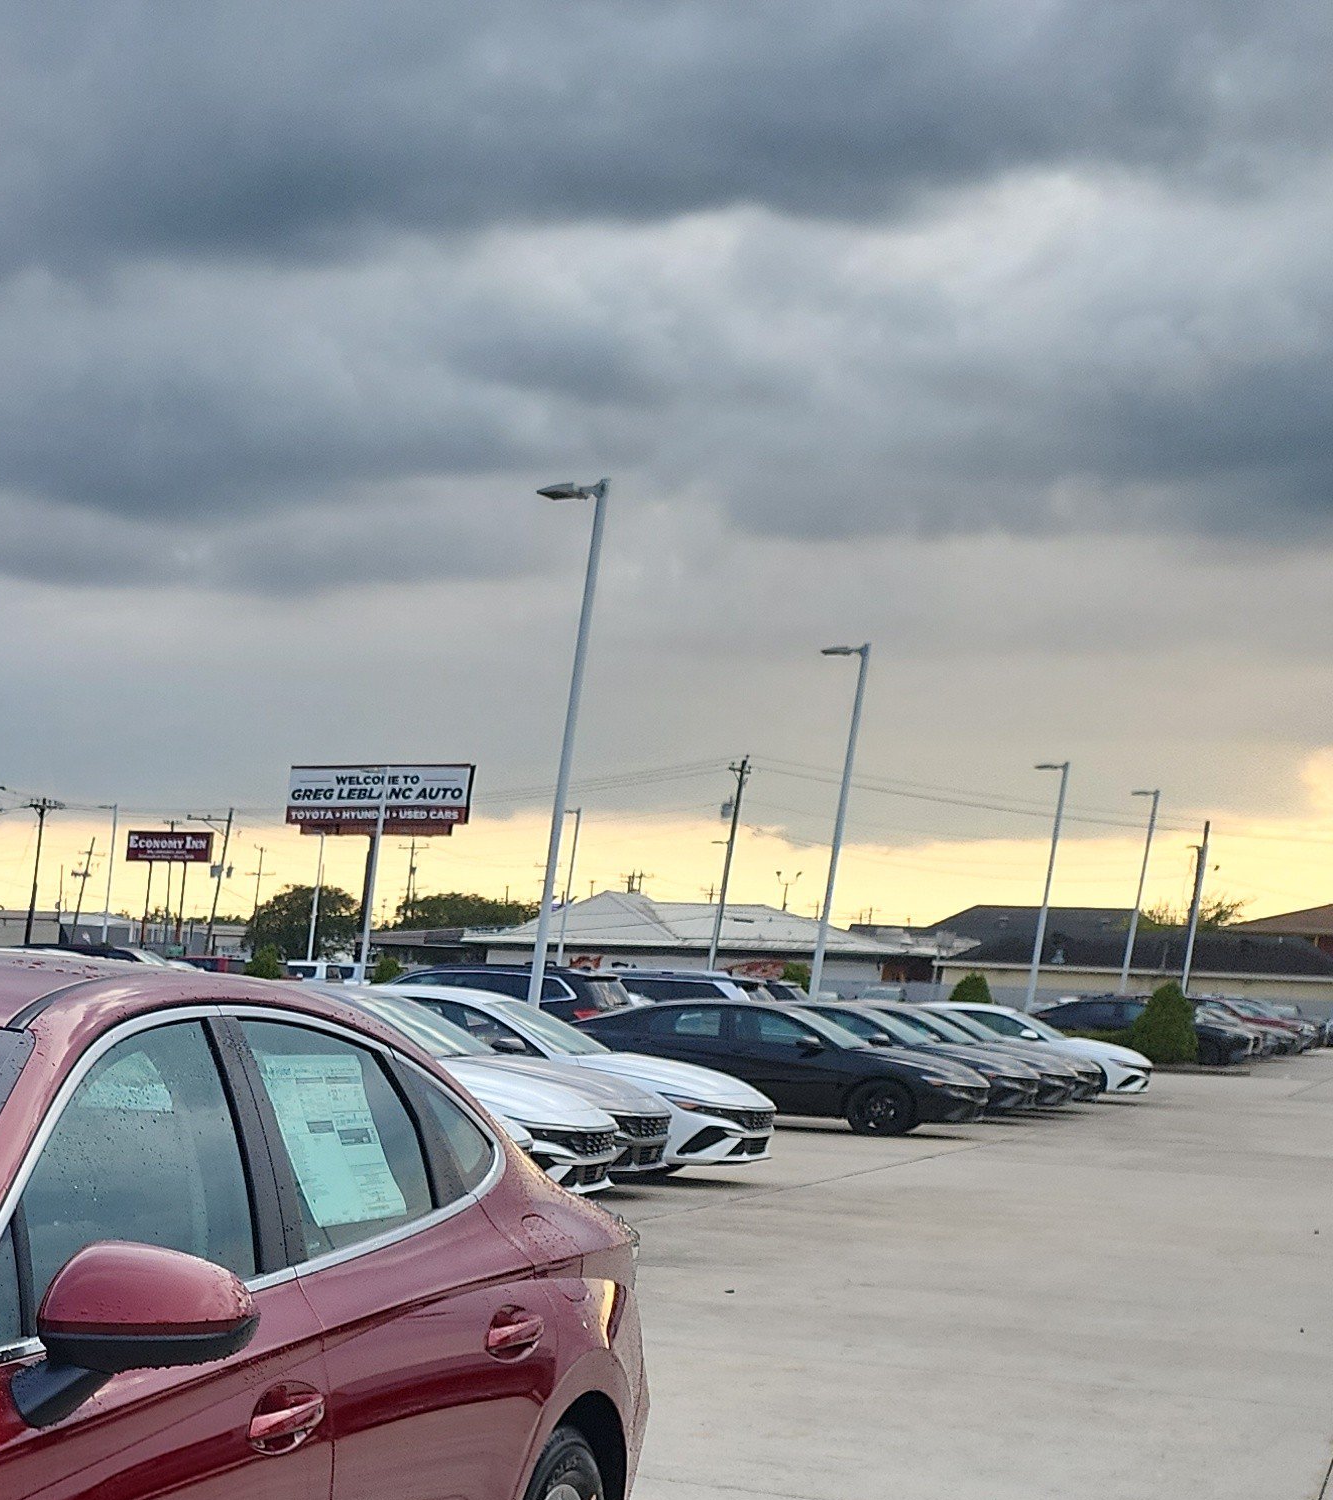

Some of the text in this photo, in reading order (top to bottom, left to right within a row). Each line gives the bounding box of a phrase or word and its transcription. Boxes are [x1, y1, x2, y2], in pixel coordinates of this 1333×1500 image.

[403, 775, 420, 785] TO
[291, 788, 334, 801] GREG
[415, 787, 463, 800] AUTO
[291, 809, 459, 820] TOYOTA HYUNDI USED CARS
